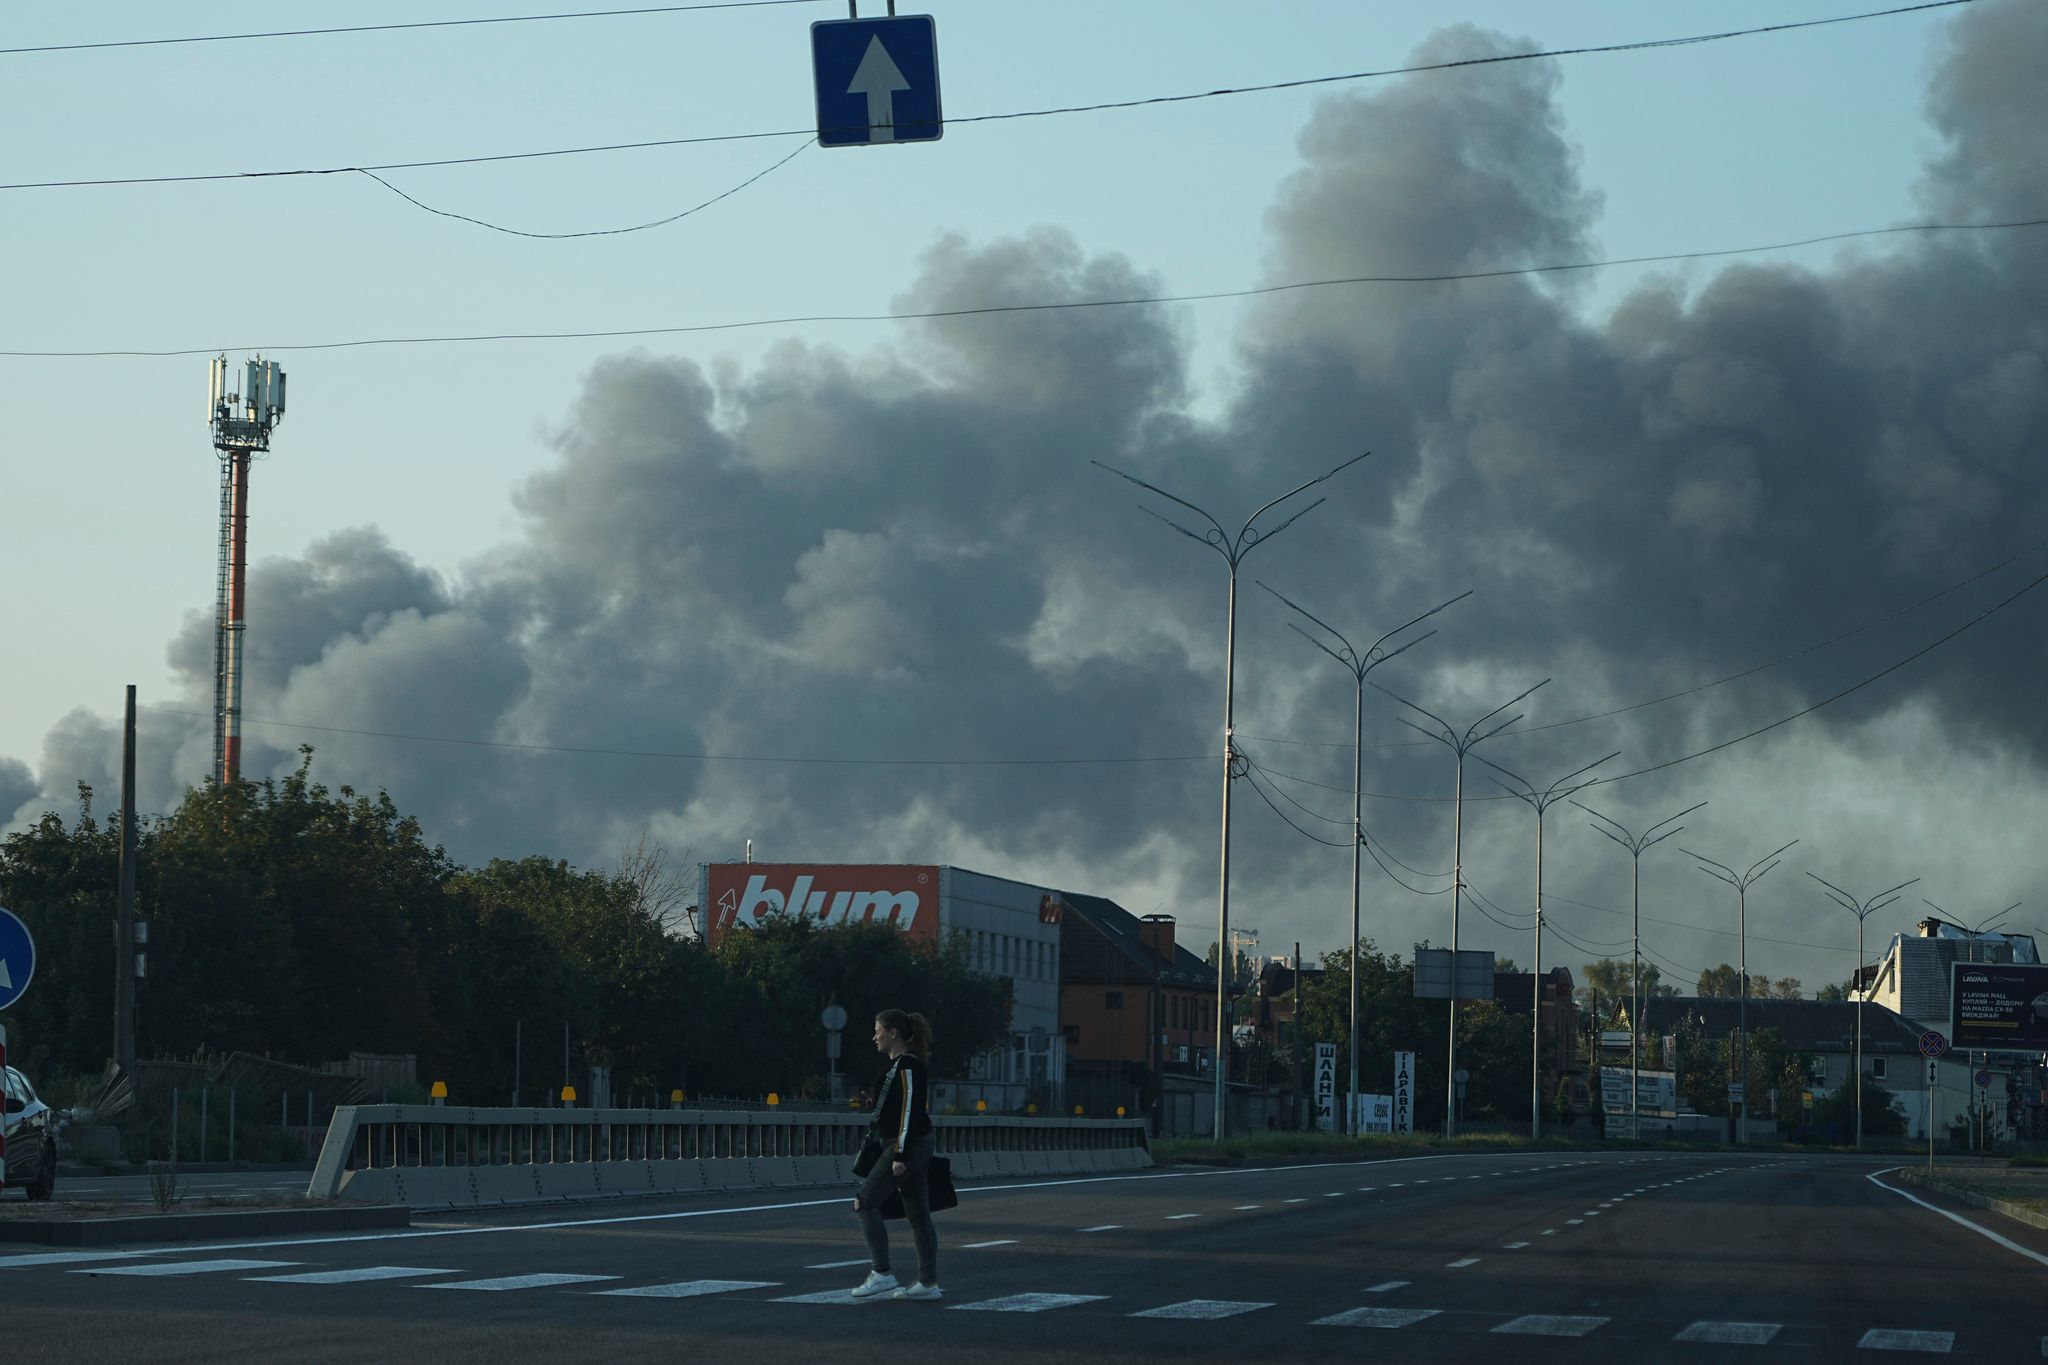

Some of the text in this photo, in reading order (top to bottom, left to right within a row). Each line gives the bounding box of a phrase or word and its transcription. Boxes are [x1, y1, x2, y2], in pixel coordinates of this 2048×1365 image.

[733, 875, 919, 931] blum
[1318, 1047, 1334, 1118] ШЛАНГИ
[1398, 1053, 1409, 1135] ГІДРАВЛІК
